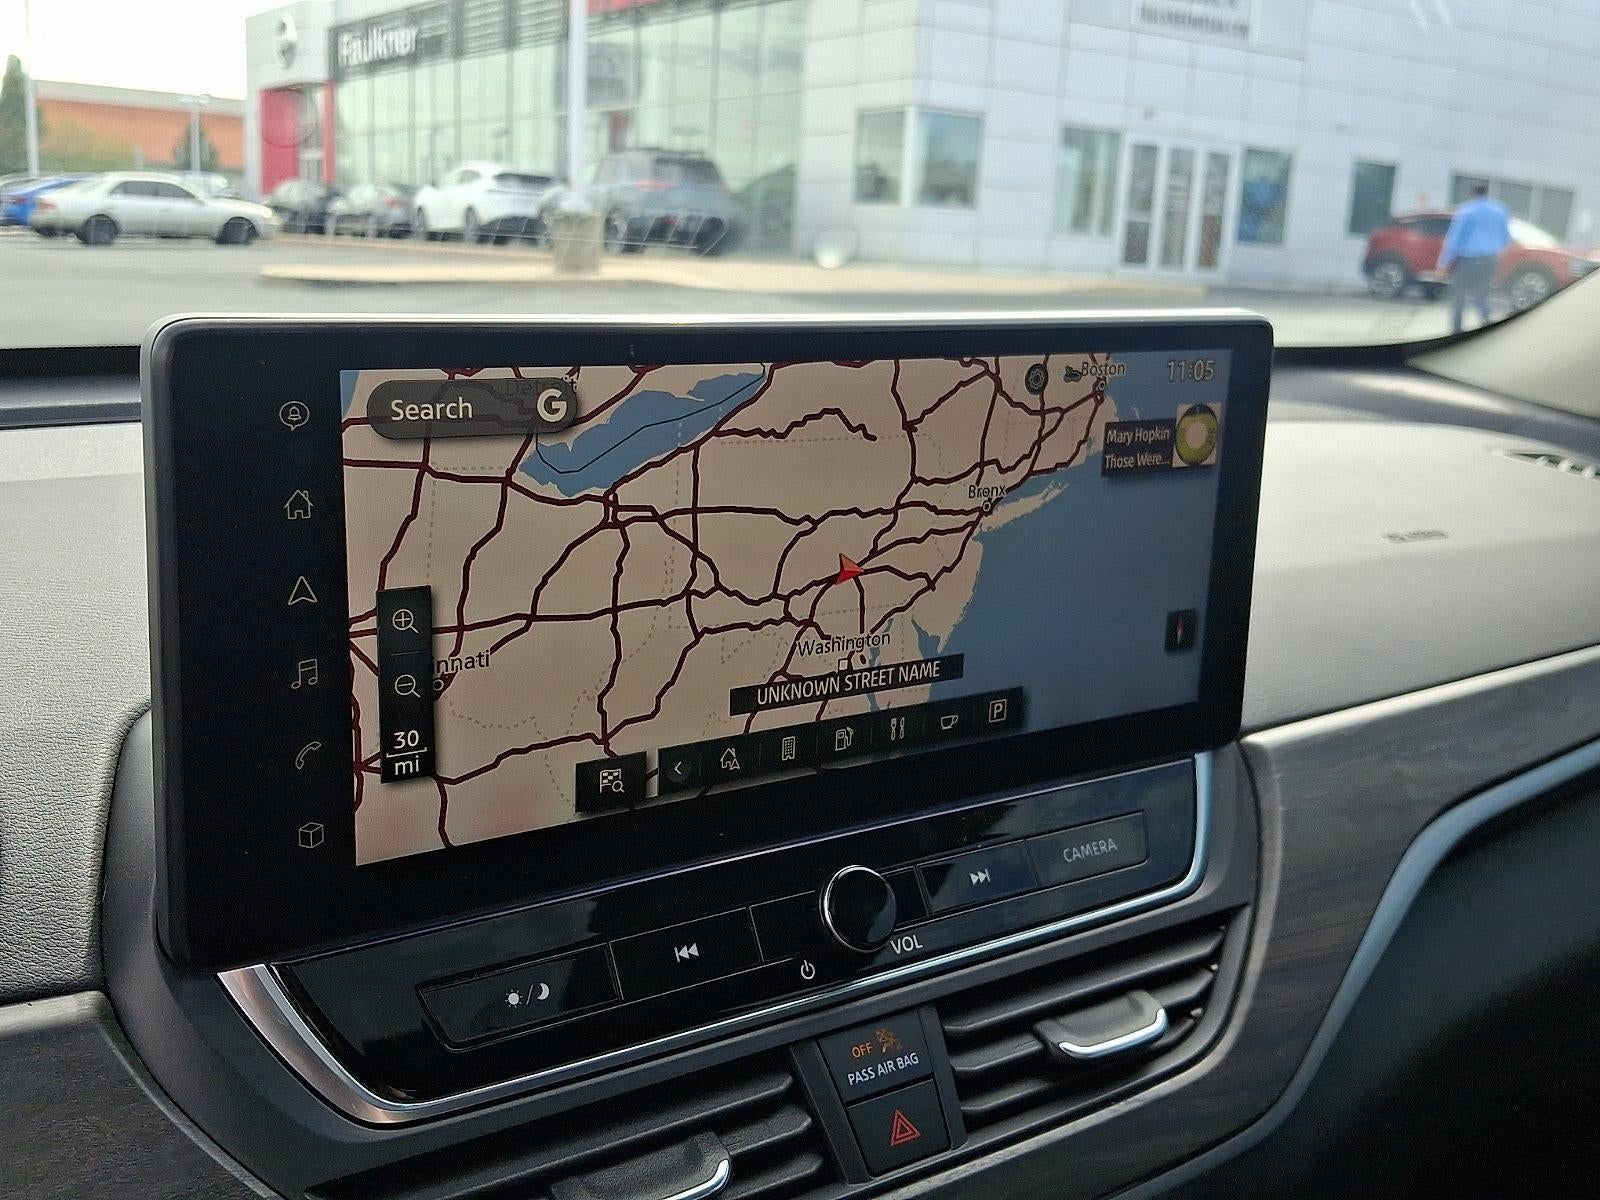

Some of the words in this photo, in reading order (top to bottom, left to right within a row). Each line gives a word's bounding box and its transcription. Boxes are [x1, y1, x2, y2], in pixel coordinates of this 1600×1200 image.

[1081, 362, 1125, 377] Boston
[1167, 360, 1215, 382] 11:05
[390, 397, 473, 421] Search
[537, 388, 568, 423] G
[1106, 429, 1133, 446] Mary
[1135, 426, 1170, 442] Hopkin
[1105, 454, 1134, 470] Those
[969, 485, 1007, 498] Bronx
[798, 632, 891, 657] Washington
[757, 676, 840, 705] UNKNOWN
[844, 668, 894, 692] STREET
[898, 660, 941, 683] NAME
[393, 729, 420, 749] 30
[394, 754, 420, 776] mi
[1063, 838, 1118, 863] CAMERA
[891, 935, 923, 955] VOL
[852, 1042, 873, 1058] OFF
[848, 1065, 876, 1086] PASS
[877, 1060, 896, 1077] AIR
[896, 1052, 919, 1071] BAG
